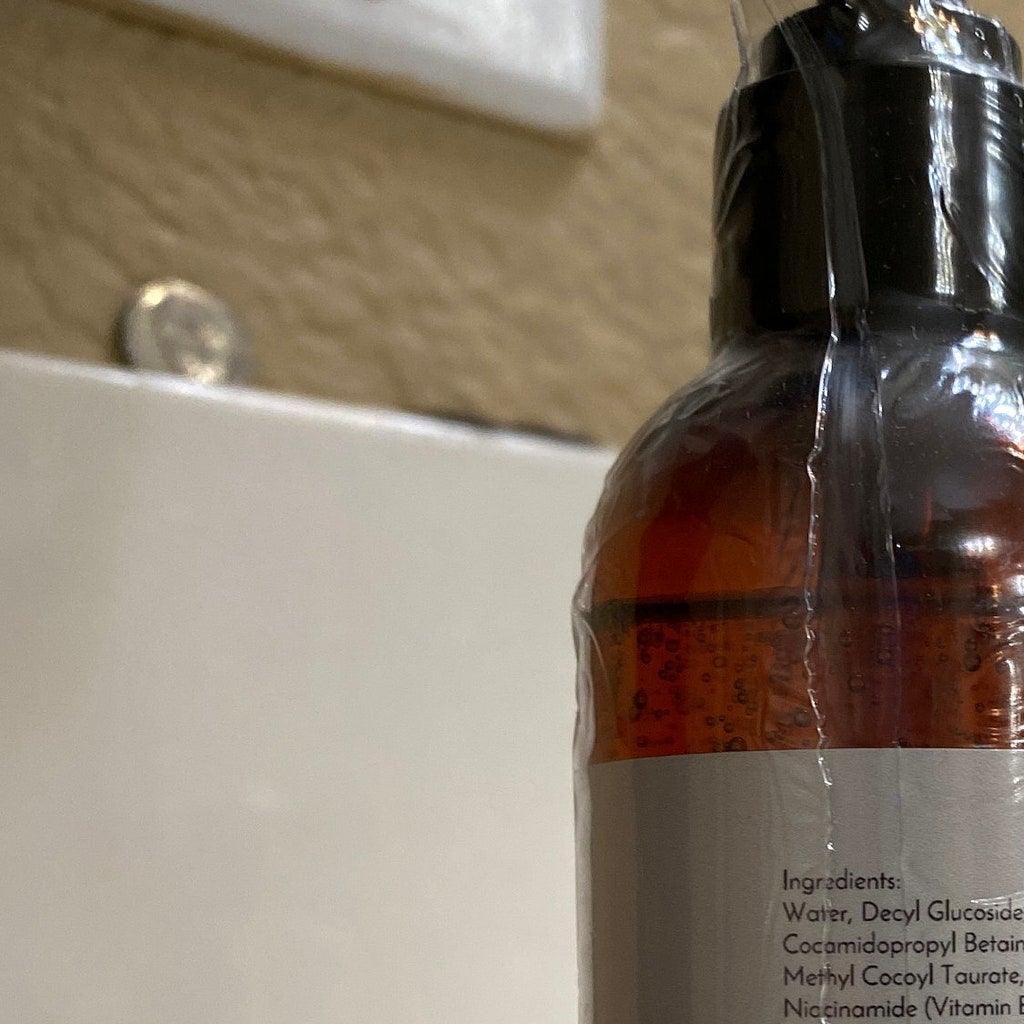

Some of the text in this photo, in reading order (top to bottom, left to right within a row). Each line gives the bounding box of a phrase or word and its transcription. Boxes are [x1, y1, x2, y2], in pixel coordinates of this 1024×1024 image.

[783, 902, 852, 924] Water,
[863, 901, 919, 926] Decyl
[783, 931, 956, 957] Cocamidopropyl
[784, 964, 854, 991] Methyl
[862, 963, 933, 989] Cocoyl
[941, 964, 1024, 986] Taurate,
[784, 996, 917, 1018] Niacinamide
[925, 995, 1010, 1020] (Vitamin
